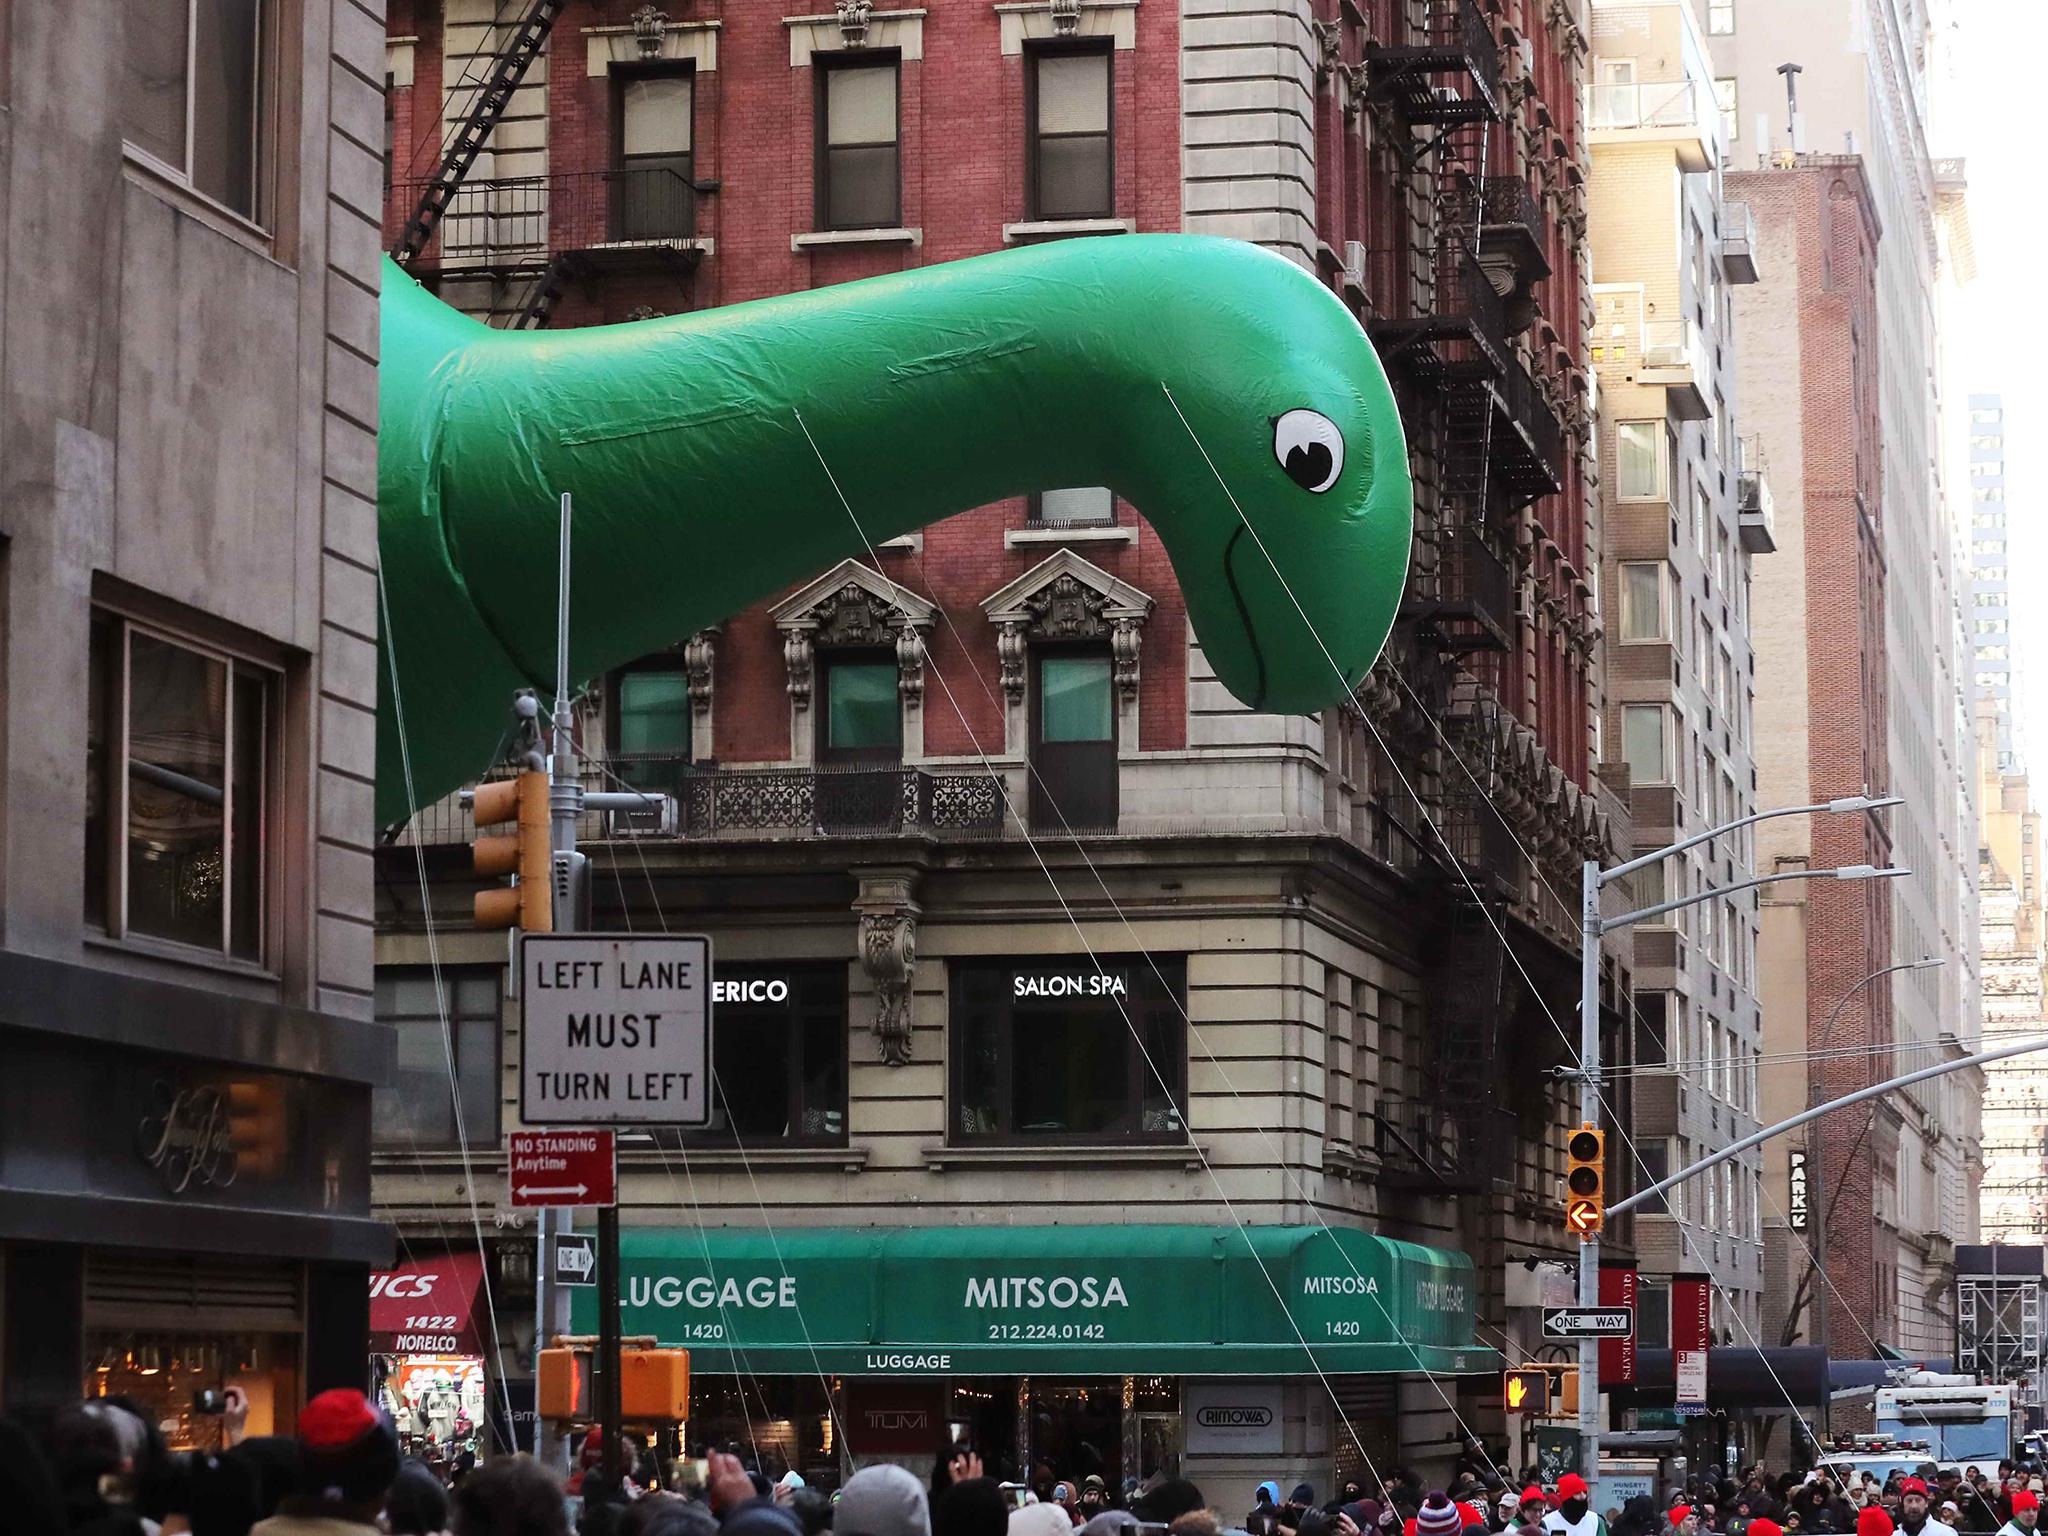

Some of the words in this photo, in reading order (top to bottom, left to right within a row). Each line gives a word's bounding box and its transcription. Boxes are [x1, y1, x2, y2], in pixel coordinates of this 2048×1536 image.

[537, 962, 603, 989] LEFT
[620, 962, 692, 989] LANE
[712, 980, 788, 1002] ERICO
[1014, 976, 1083, 996] SALON
[1089, 975, 1126, 996] SPA
[567, 1013, 661, 1048] MUST
[537, 1073, 610, 1100] TURN
[628, 1073, 693, 1100] LEFT
[515, 1138, 533, 1153] NO
[536, 1137, 597, 1152] STANDING
[516, 1156, 567, 1173] Anytime
[561, 1250, 573, 1268] ONE
[577, 1251, 590, 1269] WAY
[369, 1275, 439, 1298] ICS
[964, 1277, 1129, 1309] MITSOSA
[1304, 1276, 1378, 1295] MITSOSA
[1698, 1284, 1707, 1335] QUALITY
[405, 1316, 457, 1329] 1422
[1325, 1321, 1360, 1336] 1420
[1555, 1317, 1581, 1328] ONE
[1596, 1316, 1624, 1327] WAY
[683, 1324, 723, 1339] 1420
[988, 1324, 1105, 1339] 212.224.0142
[396, 1334, 457, 1352] NORELCO
[867, 1355, 951, 1368] LUGGAGE
[1679, 1352, 1686, 1363] 3
[1549, 1376, 1557, 1389] 7
[865, 1410, 927, 1428] TUMI
[1206, 1410, 1265, 1424] RIMOWA
